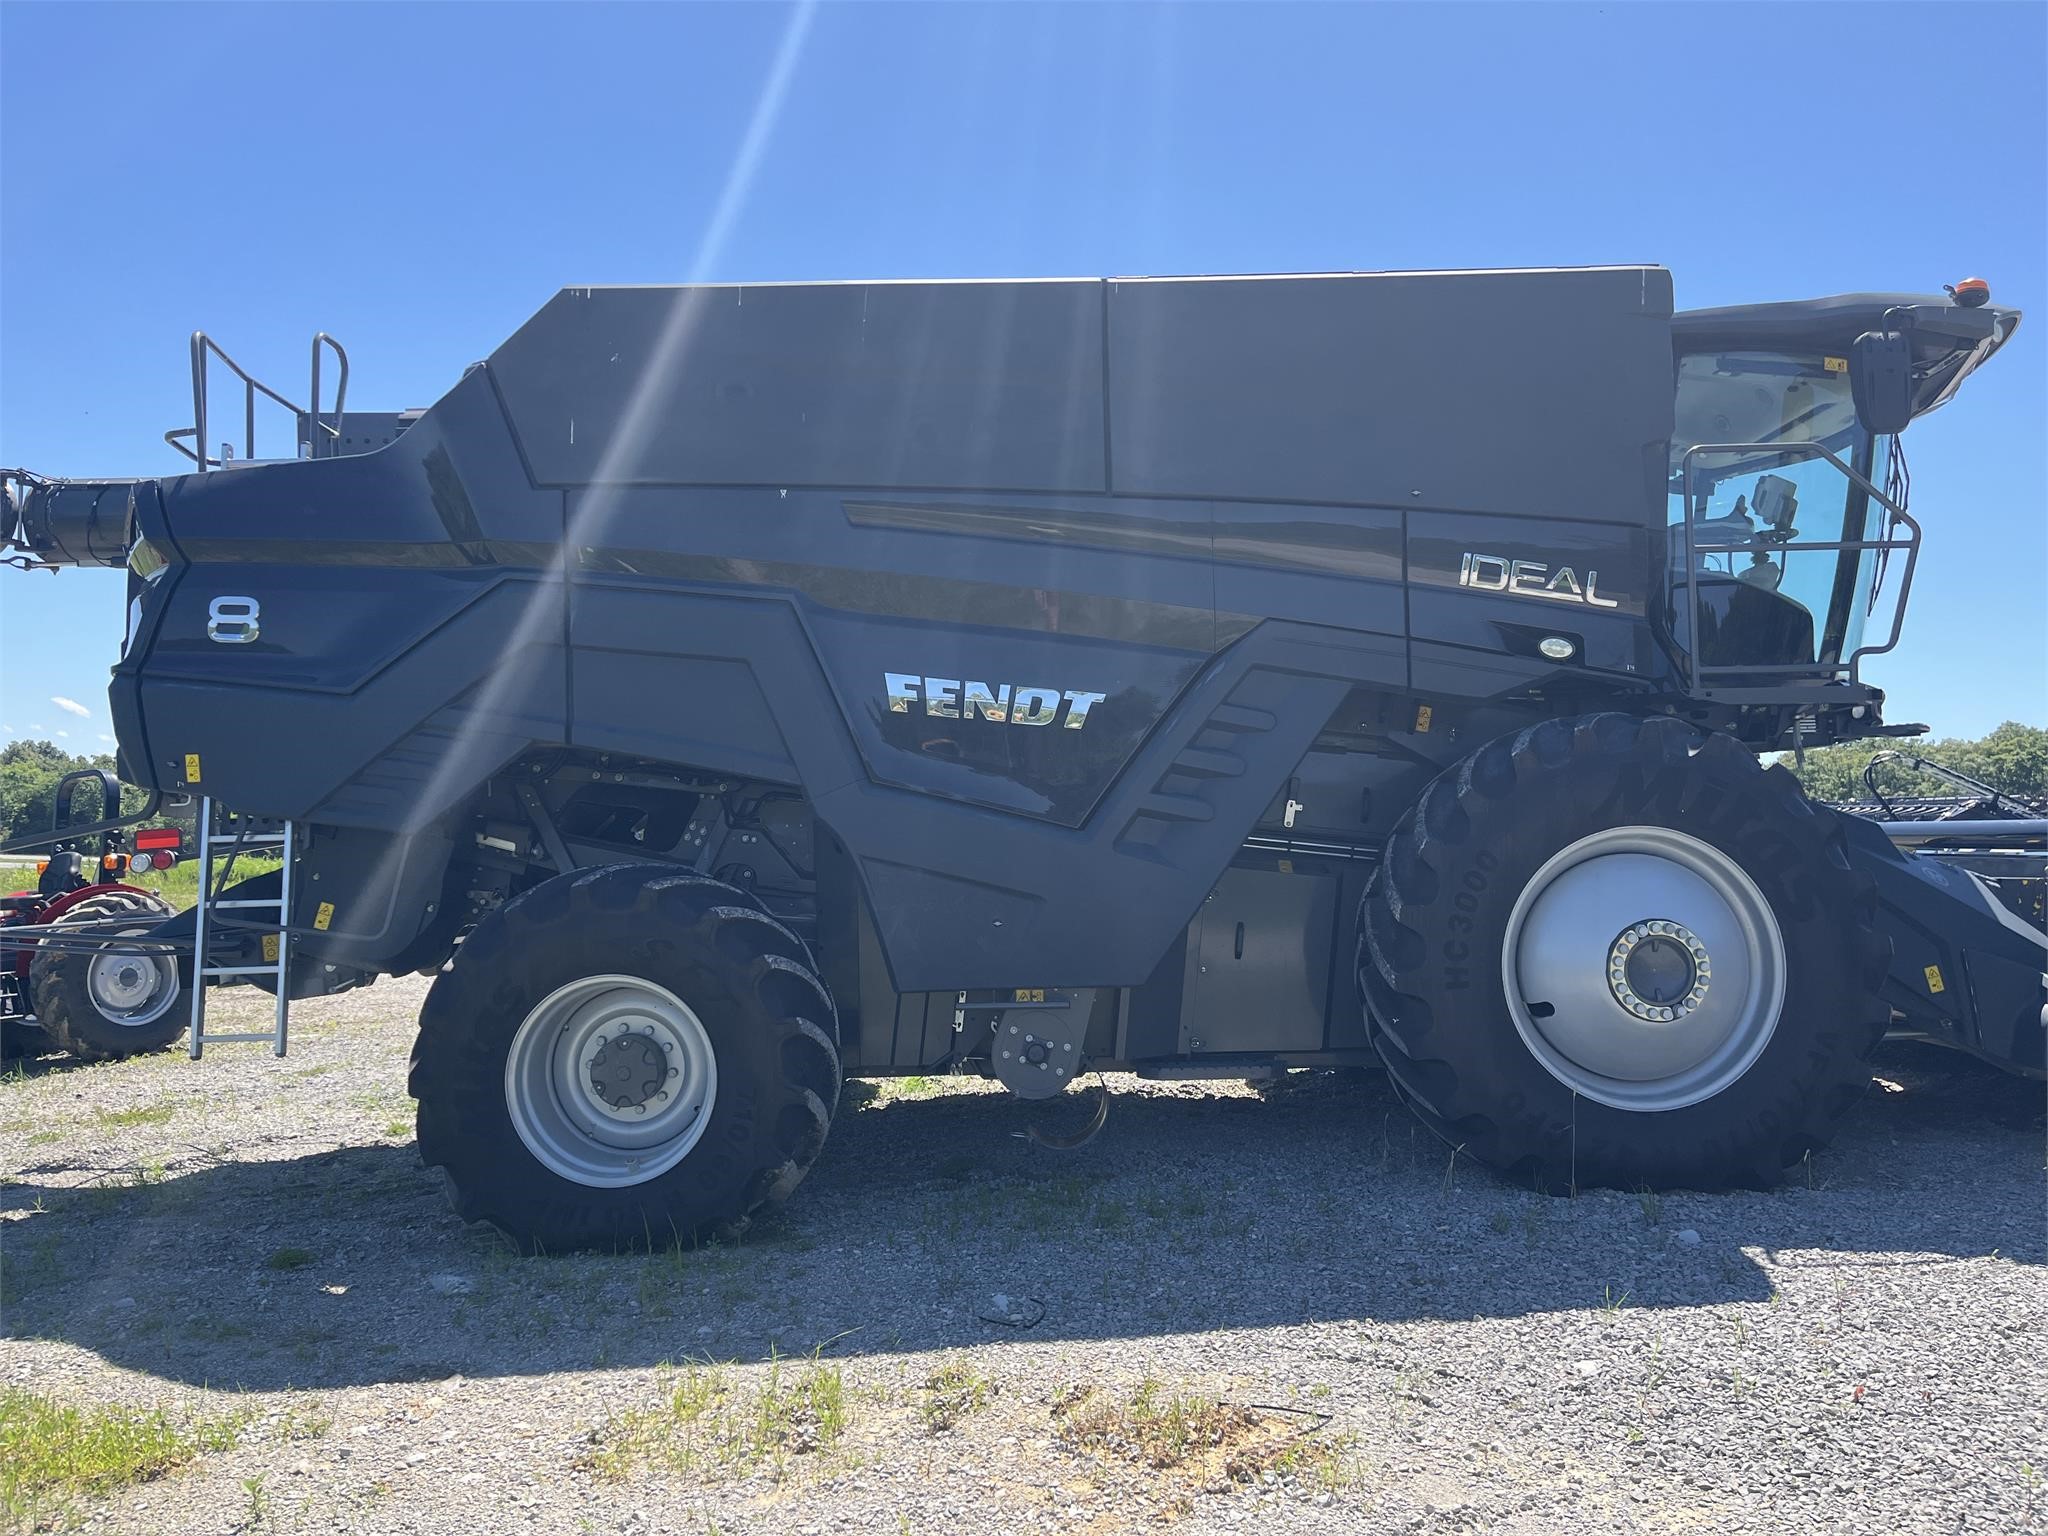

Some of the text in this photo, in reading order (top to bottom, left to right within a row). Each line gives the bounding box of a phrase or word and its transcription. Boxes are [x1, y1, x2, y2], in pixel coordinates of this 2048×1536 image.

[1459, 552, 1618, 608] IDEAL
[207, 596, 260, 644] 8
[884, 672, 1107, 730] FENDT
